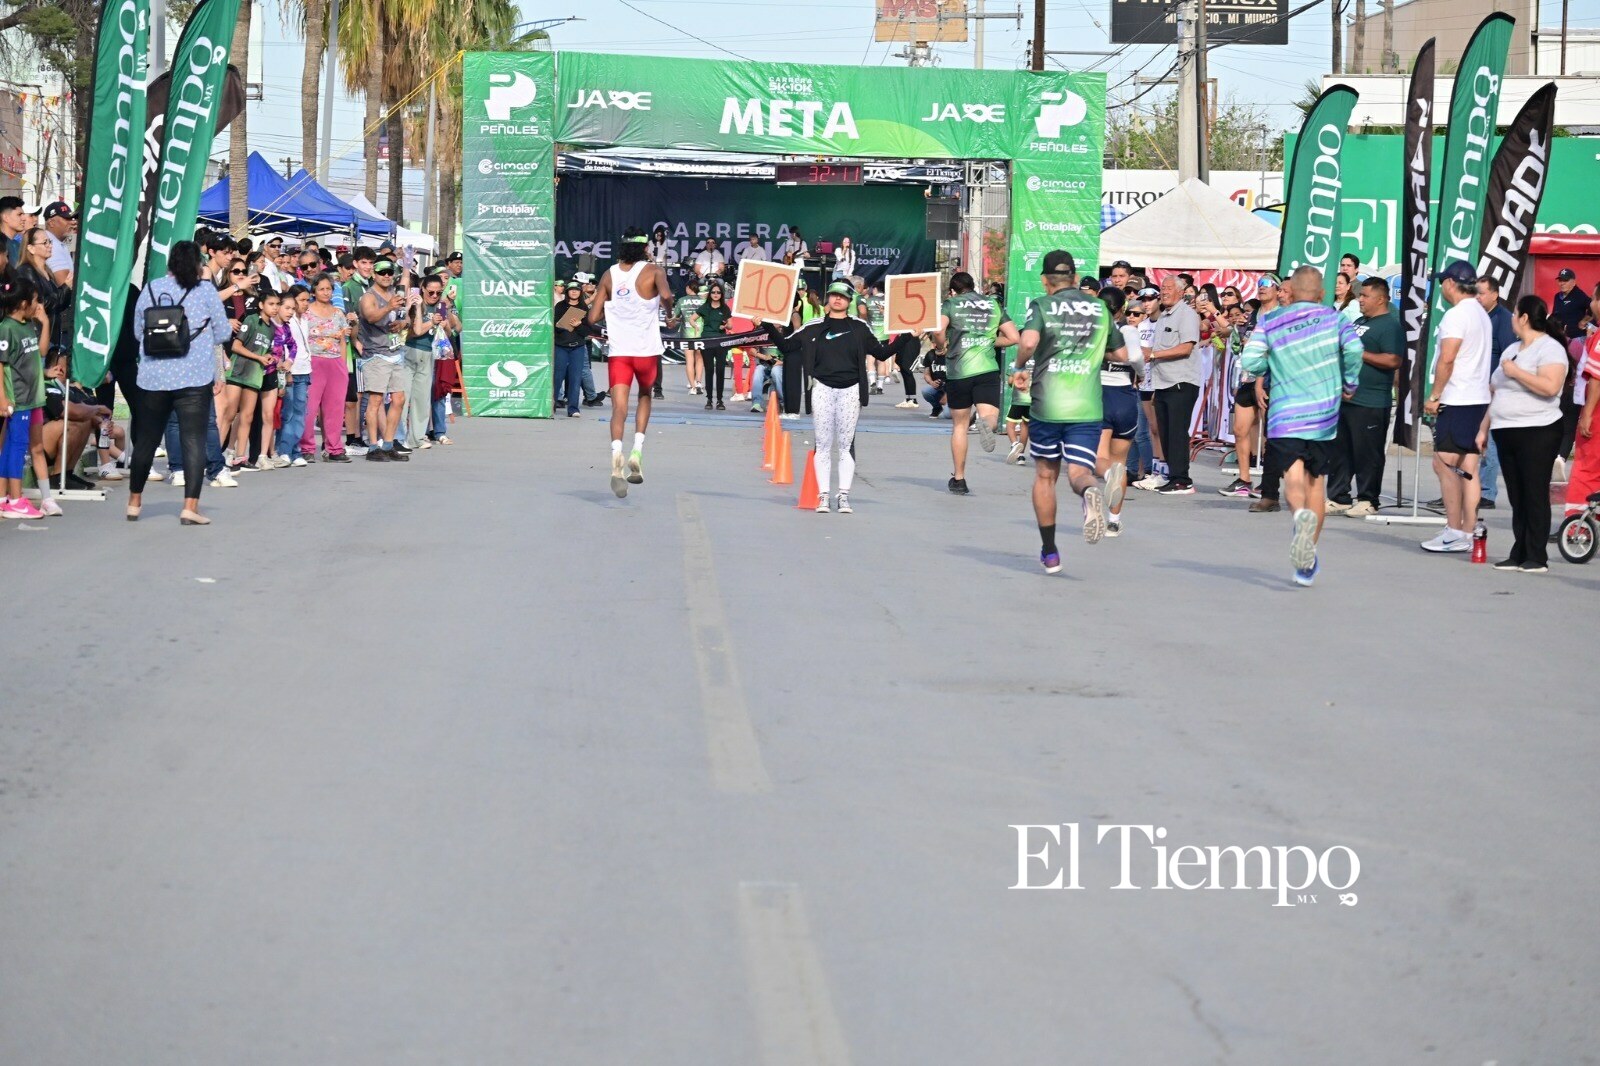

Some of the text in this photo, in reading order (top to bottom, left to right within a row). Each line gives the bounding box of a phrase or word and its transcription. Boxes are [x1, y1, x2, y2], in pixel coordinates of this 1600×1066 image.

[1228, 13, 1239, 24] MI
[1244, 13, 1278, 25] MUNDO
[137, 53, 147, 74] MX
[203, 84, 214, 102] MX
[718, 97, 860, 140] META
[480, 123, 539, 135] PEÑOLES
[1029, 141, 1088, 154] PEÑOLES
[493, 162, 540, 170] cimaco
[926, 168, 961, 179] El Tiempo
[1041, 180, 1086, 188] cimaco
[1101, 191, 1166, 209] ITRO
[1287, 123, 1343, 279] iempo
[491, 204, 536, 216] Totalplay
[653, 221, 793, 239] CARRERA
[1037, 221, 1083, 234] Totalplay
[856, 243, 900, 259] Tiempo
[857, 257, 890, 266] todos
[480, 280, 536, 296] UANE
[746, 268, 792, 316] 10
[897, 279, 927, 326] 5
[1286, 317, 1321, 333] TELLO
[488, 388, 526, 398] simas
